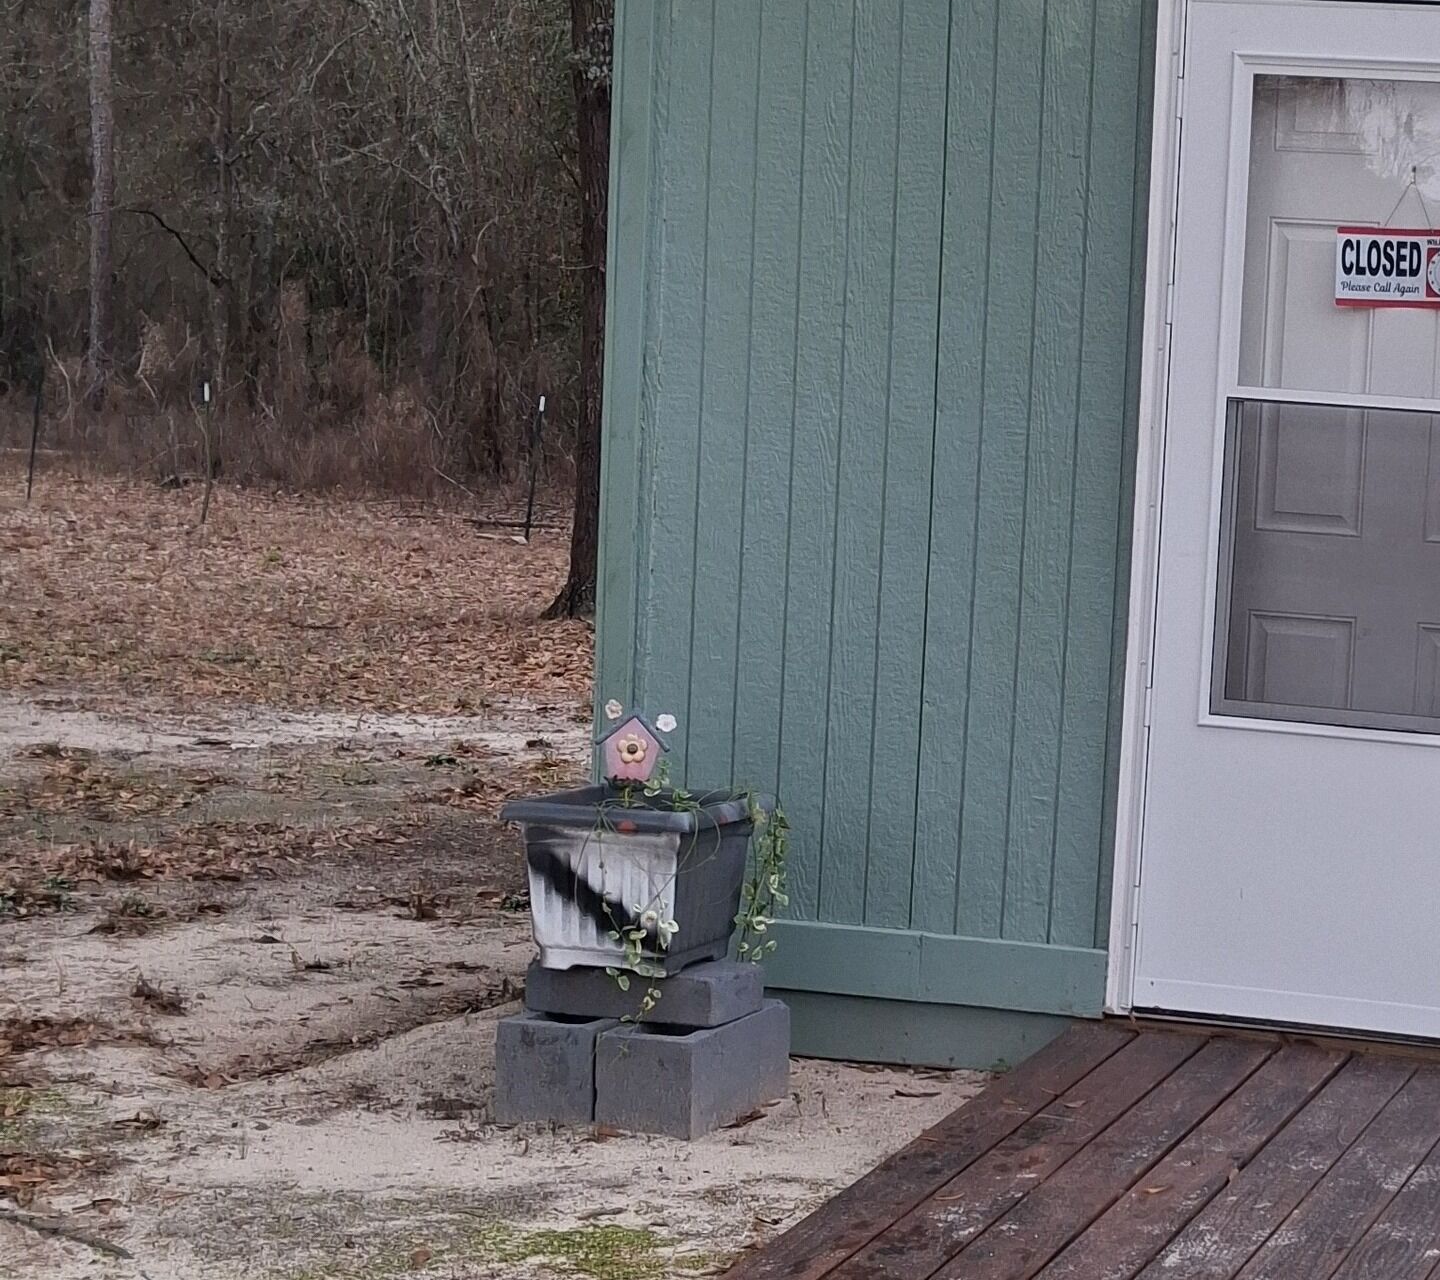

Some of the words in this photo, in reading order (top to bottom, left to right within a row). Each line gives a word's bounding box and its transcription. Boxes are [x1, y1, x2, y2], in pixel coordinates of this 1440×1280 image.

[1341, 238, 1422, 277] CLOSED
[1340, 281, 1371, 292] Please
[1373, 282, 1391, 293] Call
[1393, 283, 1420, 297] Again
